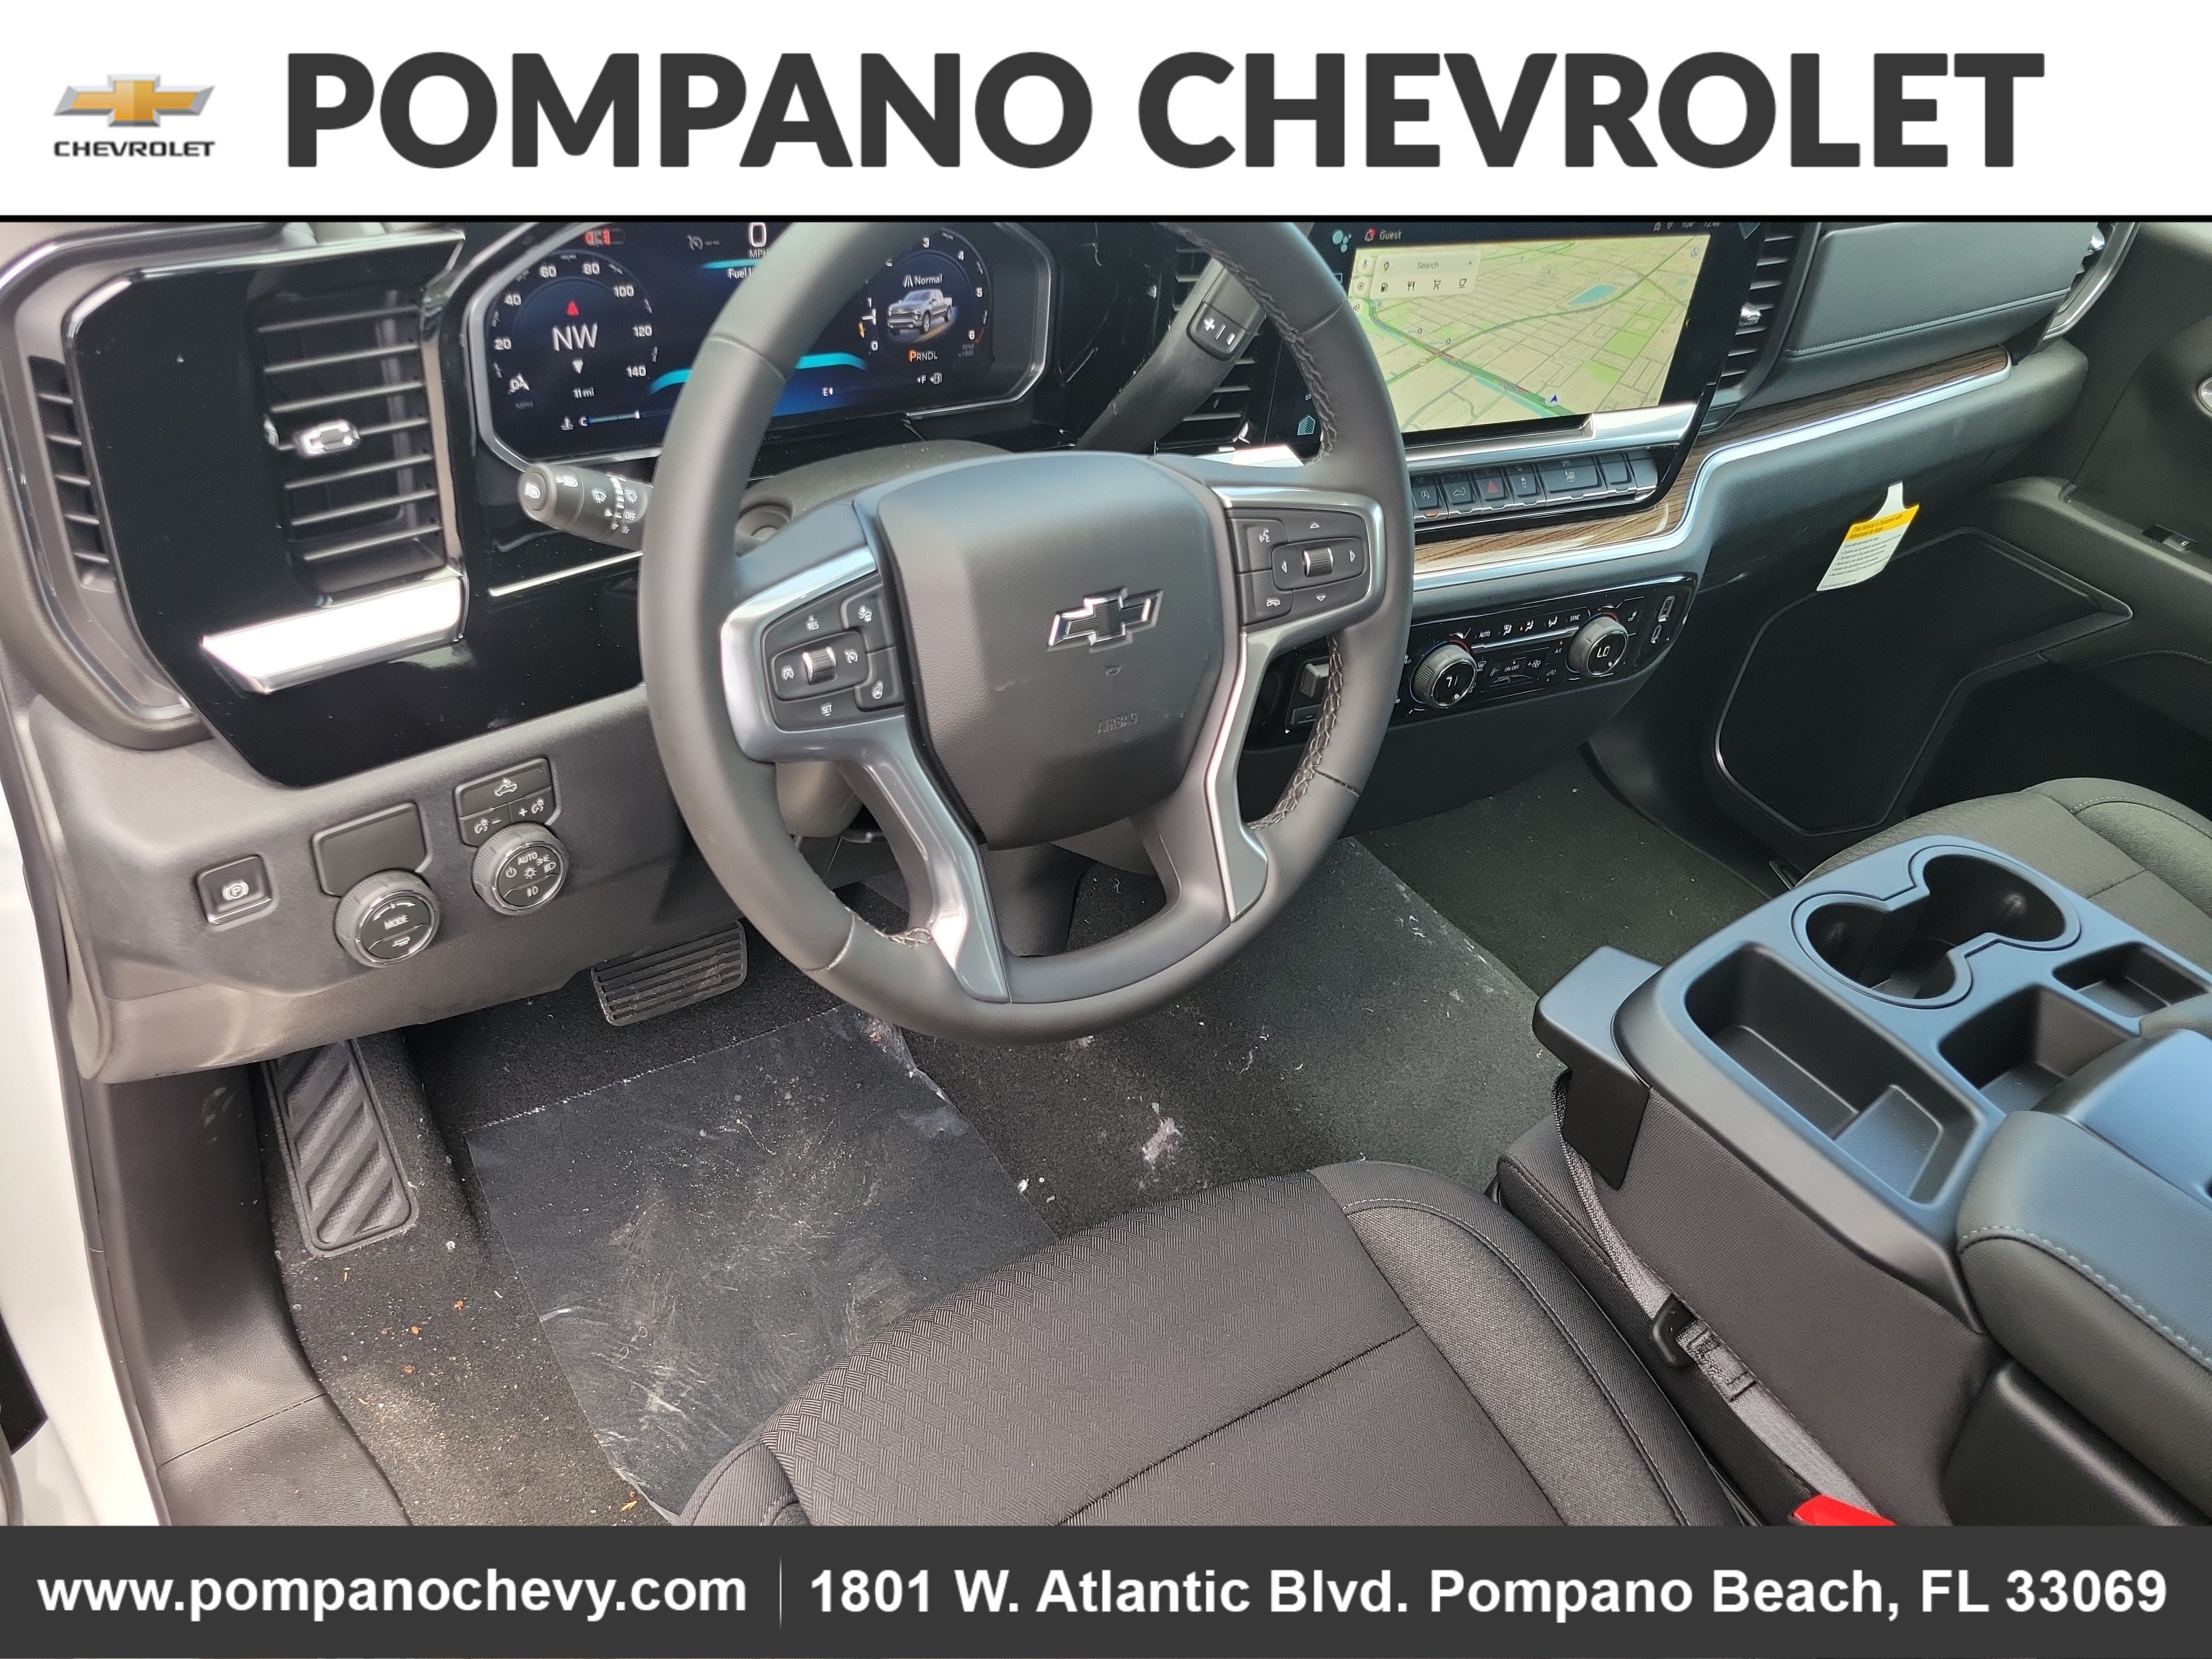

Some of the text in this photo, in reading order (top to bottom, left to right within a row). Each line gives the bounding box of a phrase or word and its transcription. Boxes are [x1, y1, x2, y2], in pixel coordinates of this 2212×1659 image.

[749, 222, 767, 247] 0
[1379, 230, 1402, 240] Guest
[922, 238, 929, 247] 3
[957, 251, 964, 261] 4
[582, 262, 600, 275] 80
[1417, 261, 1439, 270] Search
[539, 265, 557, 278] 60
[727, 267, 747, 279] Fuel
[915, 274, 943, 286] Normal
[613, 285, 634, 298] 100
[976, 287, 983, 297] 5
[504, 294, 521, 306] 40
[867, 297, 872, 308] 1
[633, 324, 652, 337] 120
[968, 330, 975, 340] 6
[552, 323, 598, 351] NW
[494, 337, 512, 350] 20
[871, 341, 878, 351] 0
[627, 365, 646, 378] 140
[921, 375, 927, 384] F
[582, 387, 595, 398] mi
[823, 387, 828, 396] E
[579, 416, 588, 426] C
[625, 511, 637, 521] OFF
[808, 622, 819, 630] RES
[1596, 646, 1611, 658] LO
[1504, 664, 1520, 673] ON/OFF
[1446, 675, 1458, 688] 71
[822, 704, 832, 714] SET
[517, 851, 538, 865] AUTO
[384, 915, 409, 930] MODE
